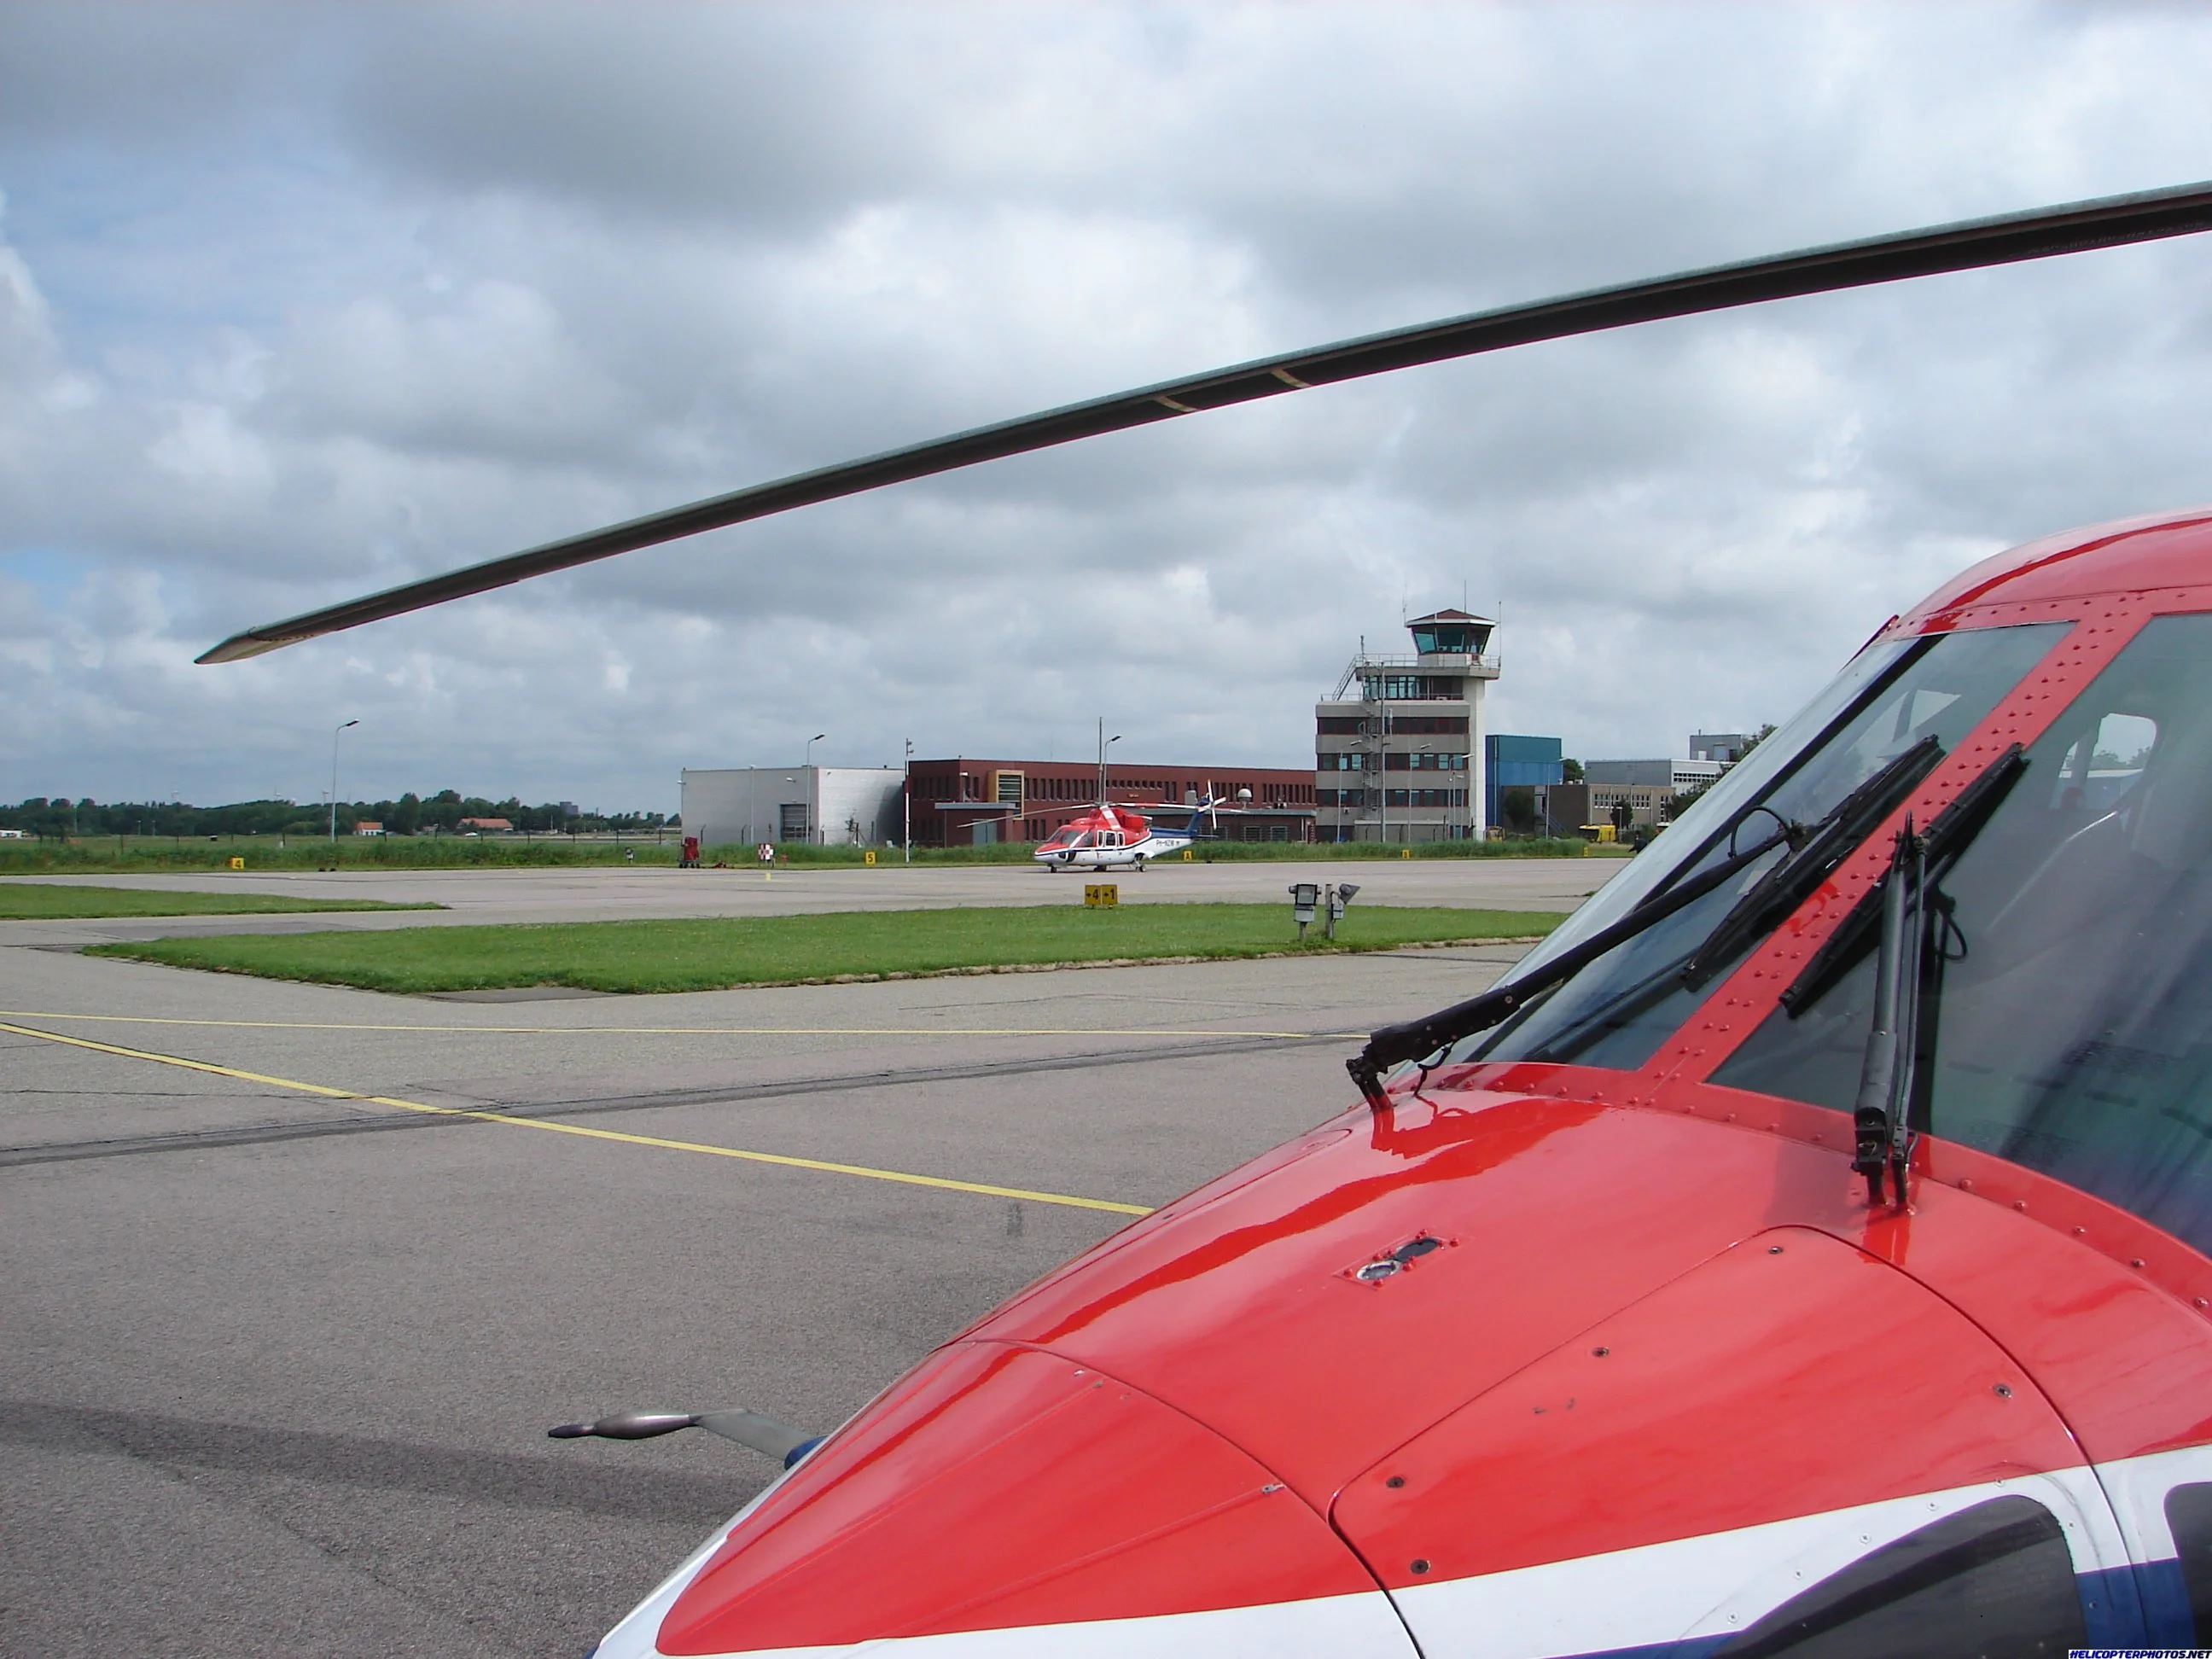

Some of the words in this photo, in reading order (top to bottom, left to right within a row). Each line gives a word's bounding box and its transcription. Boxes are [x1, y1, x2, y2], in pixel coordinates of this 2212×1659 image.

[868, 853, 873, 862] 5
[235, 859, 242, 868] 4
[1092, 888, 1099, 900] 4
[1110, 888, 1115, 899] 1
